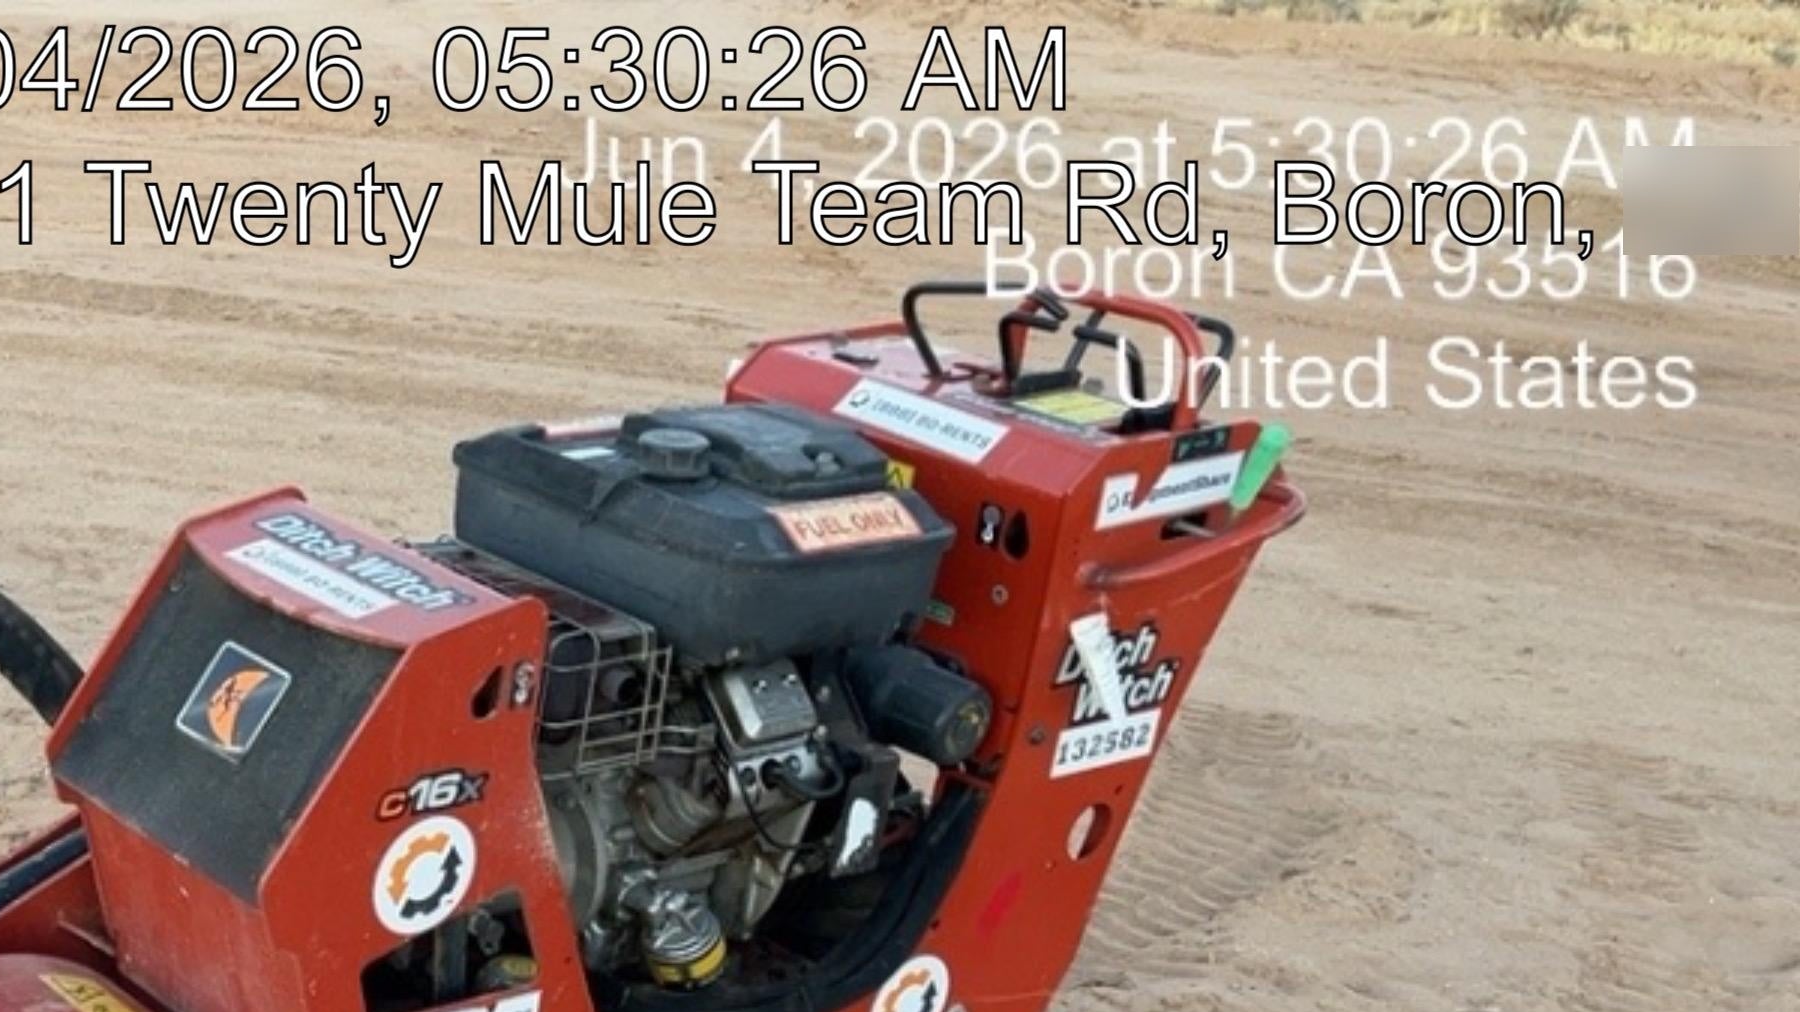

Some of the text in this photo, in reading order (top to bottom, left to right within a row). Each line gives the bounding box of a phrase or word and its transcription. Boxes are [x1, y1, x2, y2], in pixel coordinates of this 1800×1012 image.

[793, 507, 904, 541] FUEL ONLY
[256, 513, 456, 610] Ditch Witch
[1057, 723, 1151, 766] 132582
